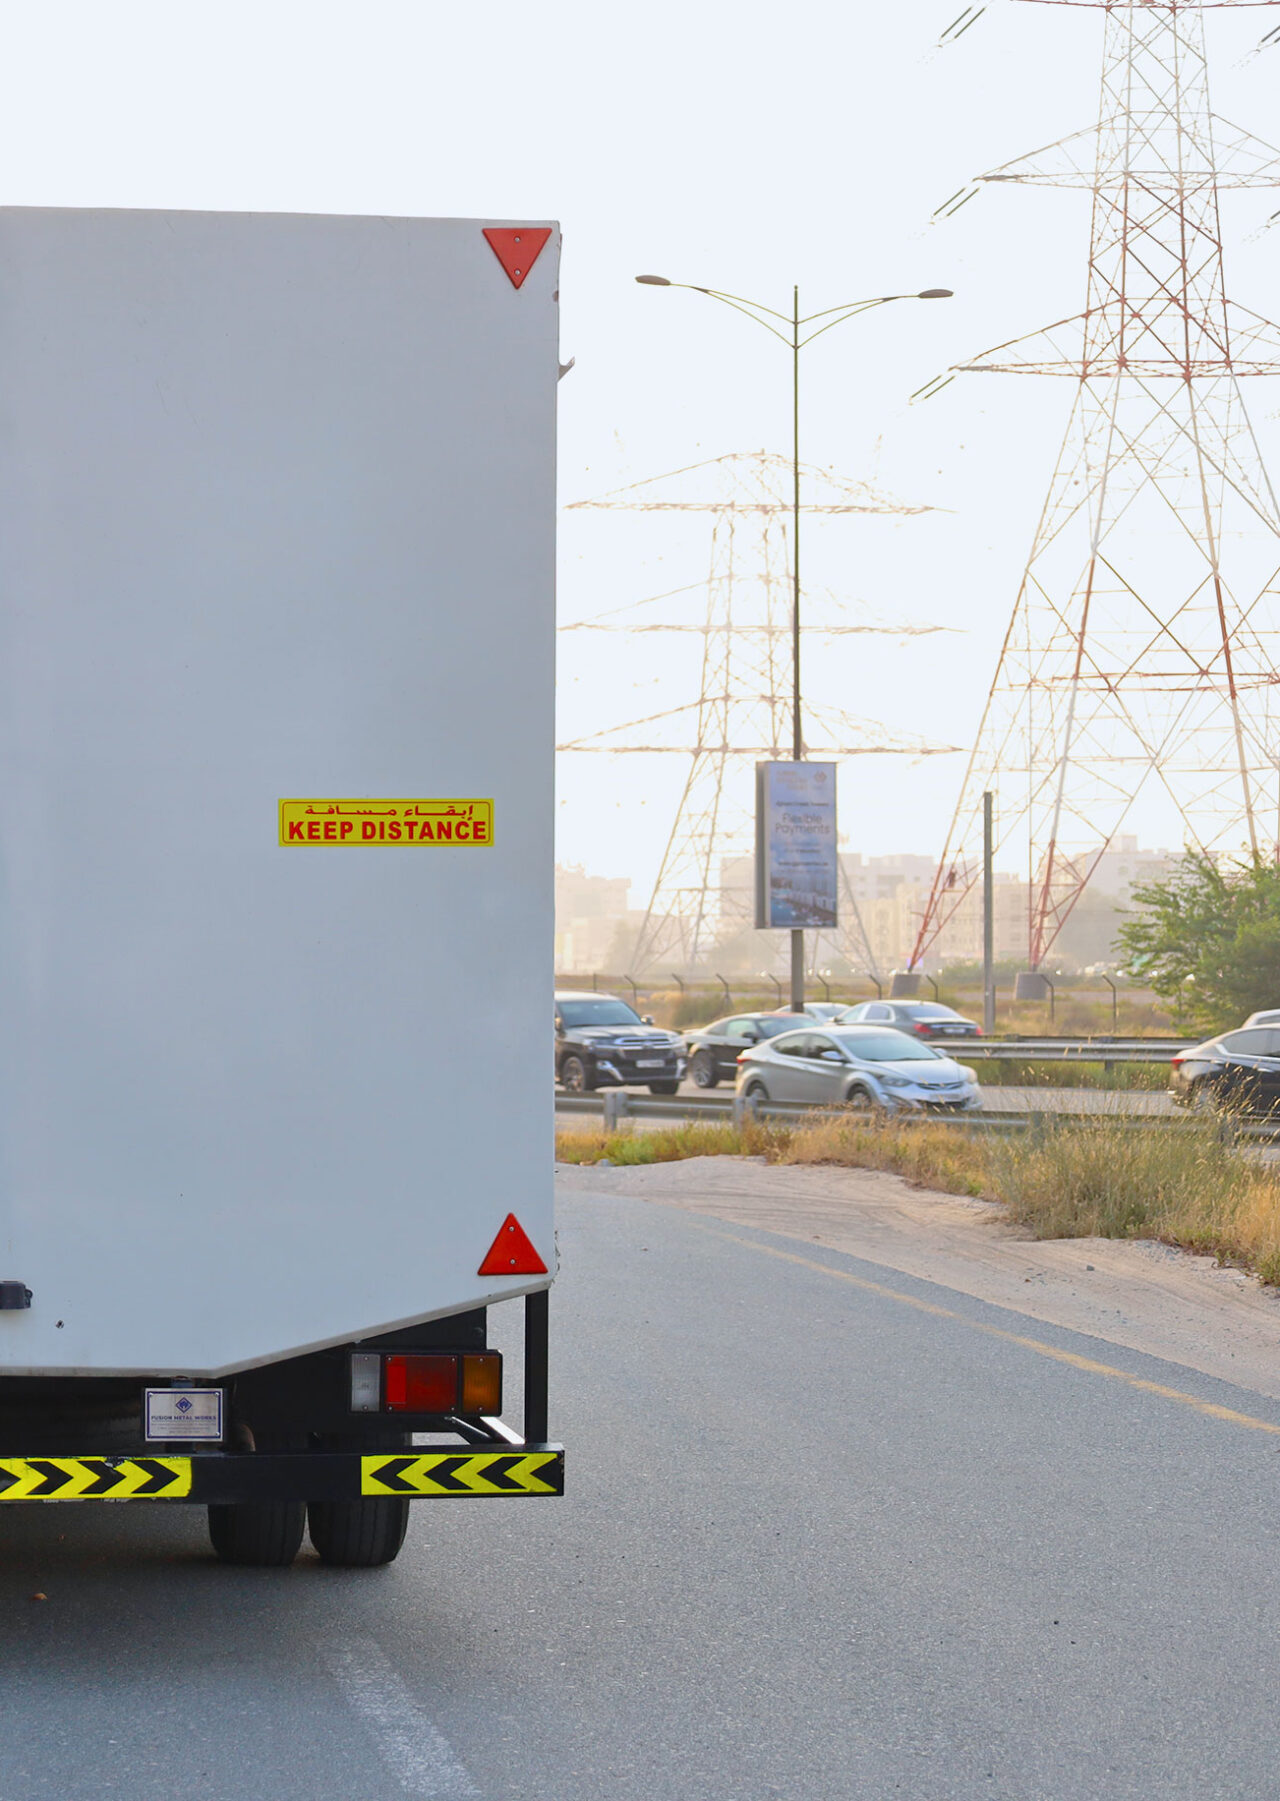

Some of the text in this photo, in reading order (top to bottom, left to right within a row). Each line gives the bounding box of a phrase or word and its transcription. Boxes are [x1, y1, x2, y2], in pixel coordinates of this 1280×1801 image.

[305, 805, 474, 821] إبقاء مسافة
[288, 821, 487, 840] KEEP DISTANCE
[775, 823, 831, 836] Payments
